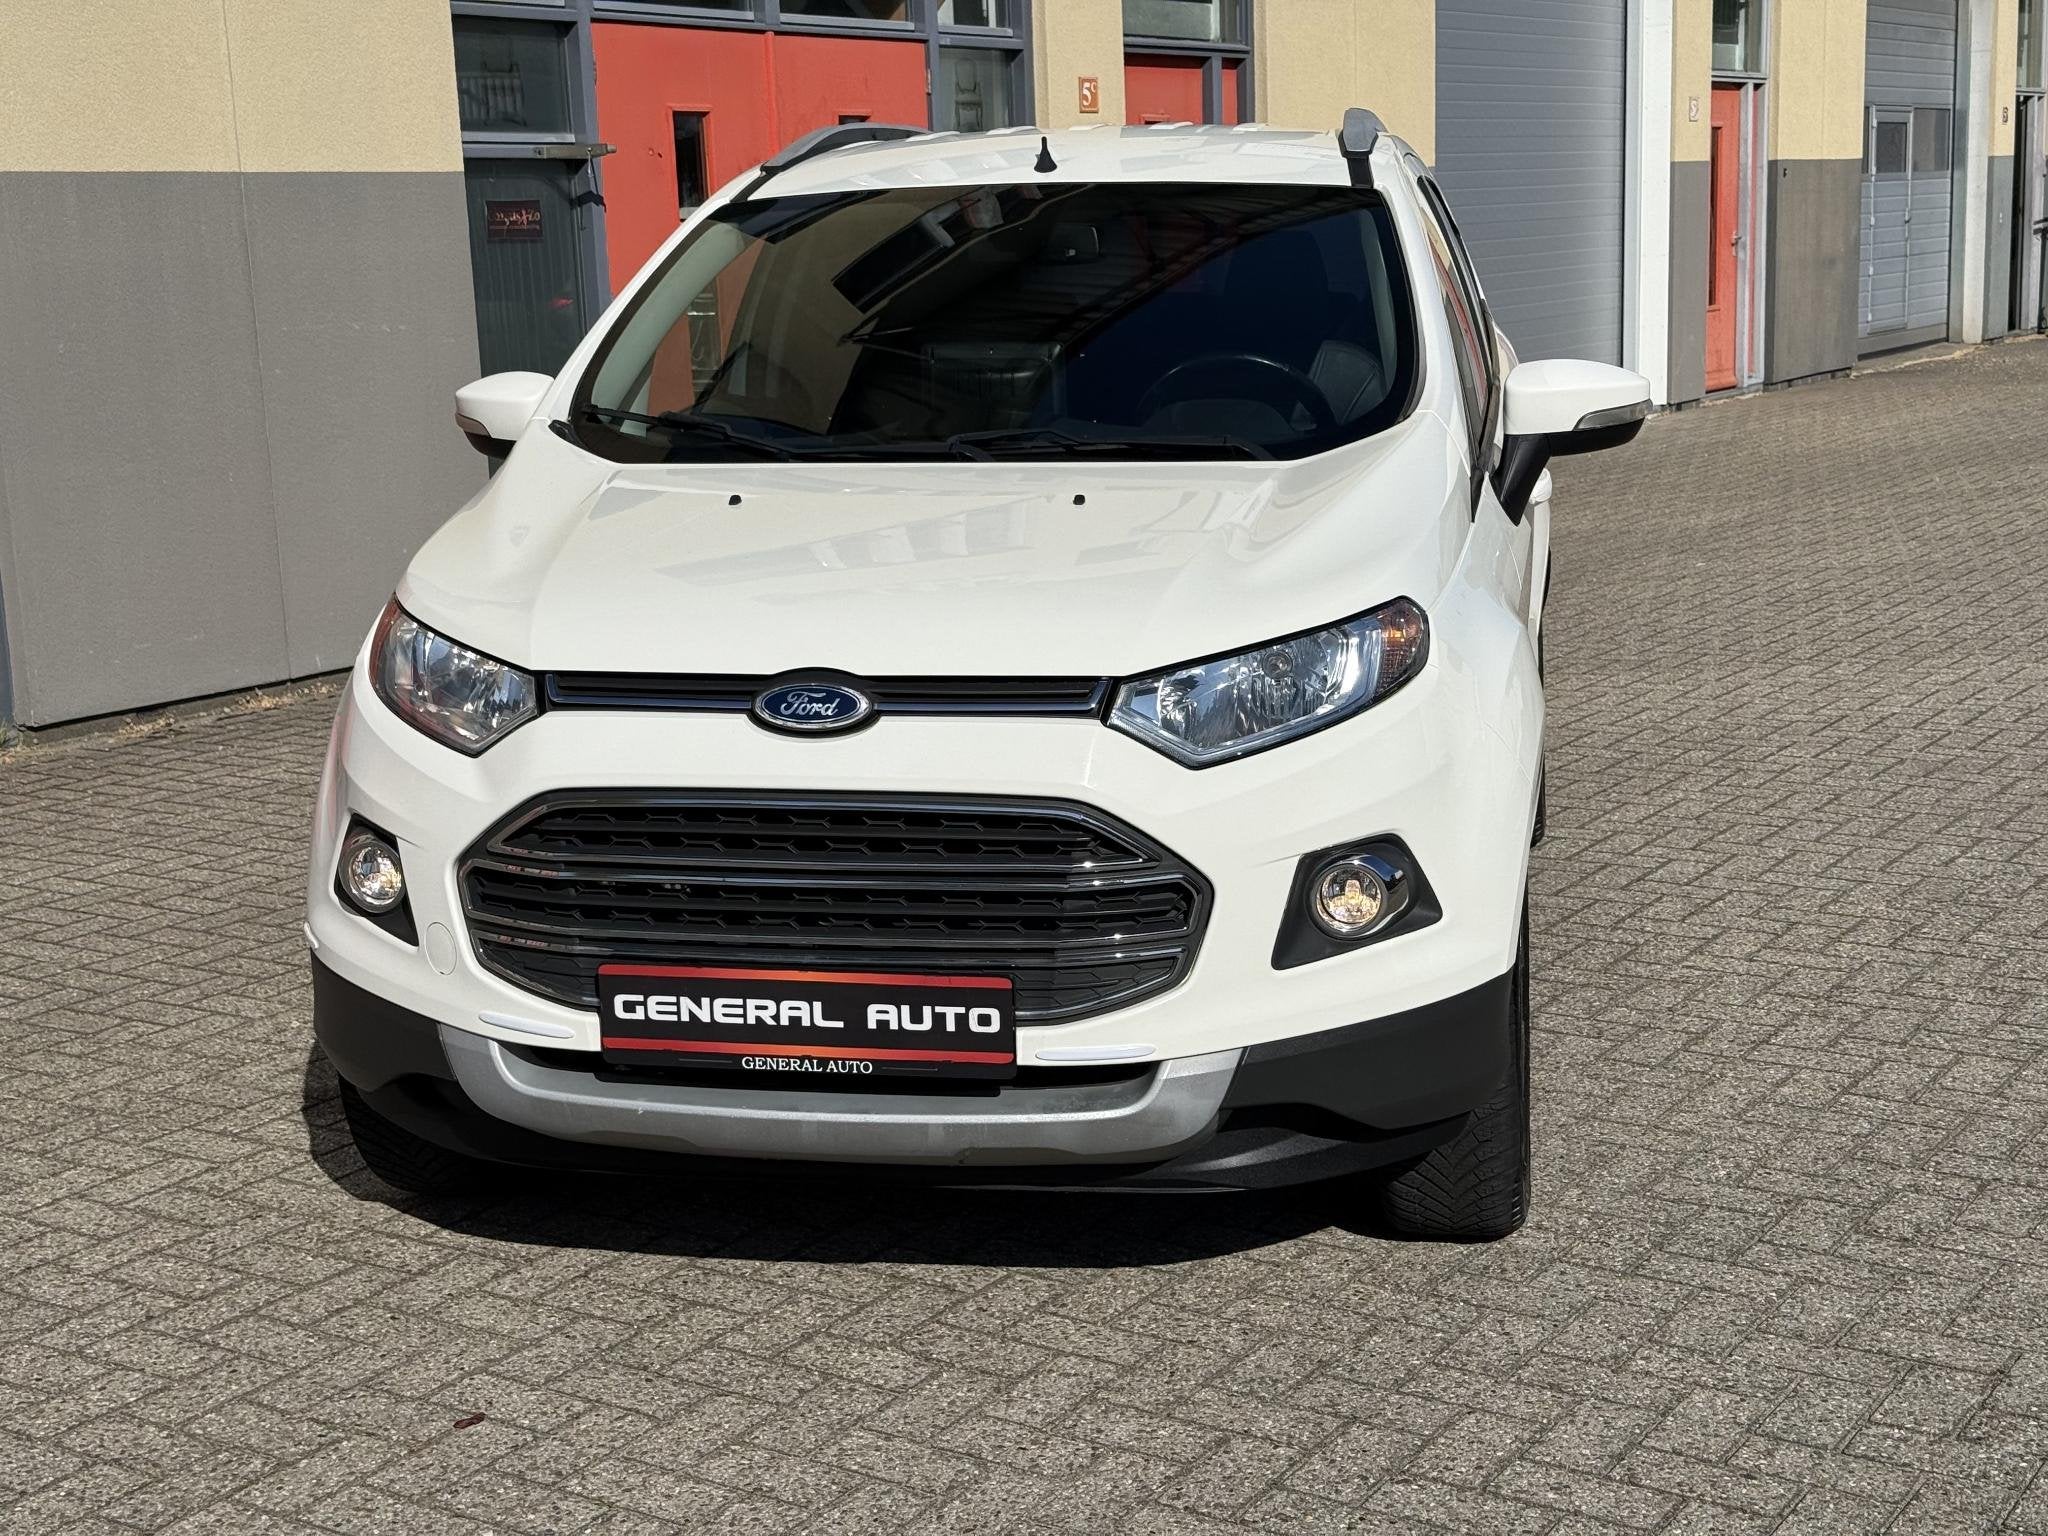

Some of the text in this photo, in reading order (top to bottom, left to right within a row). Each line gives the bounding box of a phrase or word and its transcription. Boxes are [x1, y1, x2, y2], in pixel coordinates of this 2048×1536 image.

[780, 691, 840, 715] Ford
[614, 994, 1001, 1034] GENERAL AUTO
[741, 1056, 873, 1074] GENERAL AUTO
